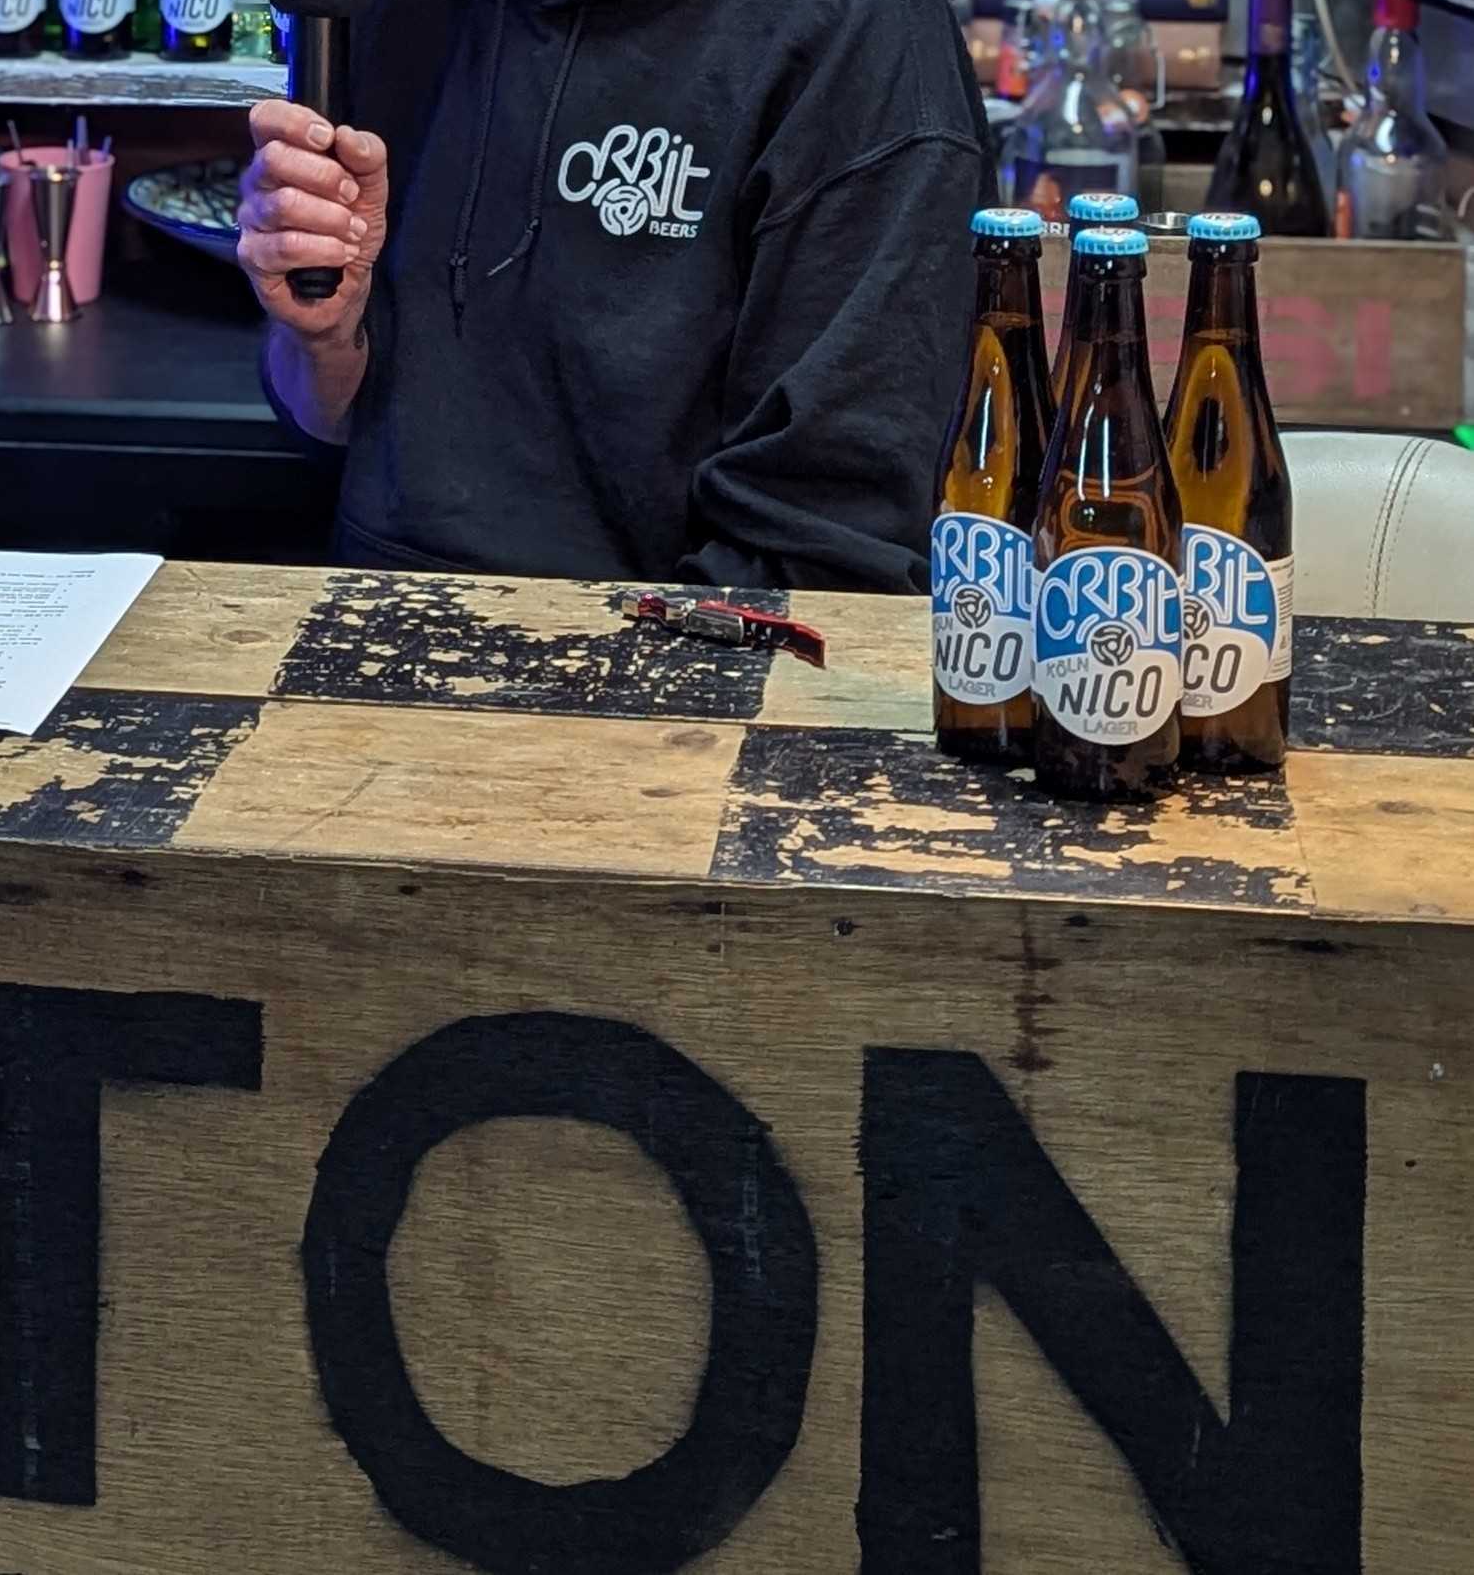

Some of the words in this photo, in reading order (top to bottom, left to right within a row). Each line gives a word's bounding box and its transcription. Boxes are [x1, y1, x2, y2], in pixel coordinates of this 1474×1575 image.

[649, 221, 698, 238] BEERS
[935, 631, 1024, 682] NICO
[1046, 658, 1089, 677] KÖLN
[1183, 643, 1242, 694] CO
[948, 676, 996, 697] LAGER
[1057, 665, 1163, 718] NICO
[1182, 692, 1213, 709] GER
[1083, 719, 1139, 736] LAGER
